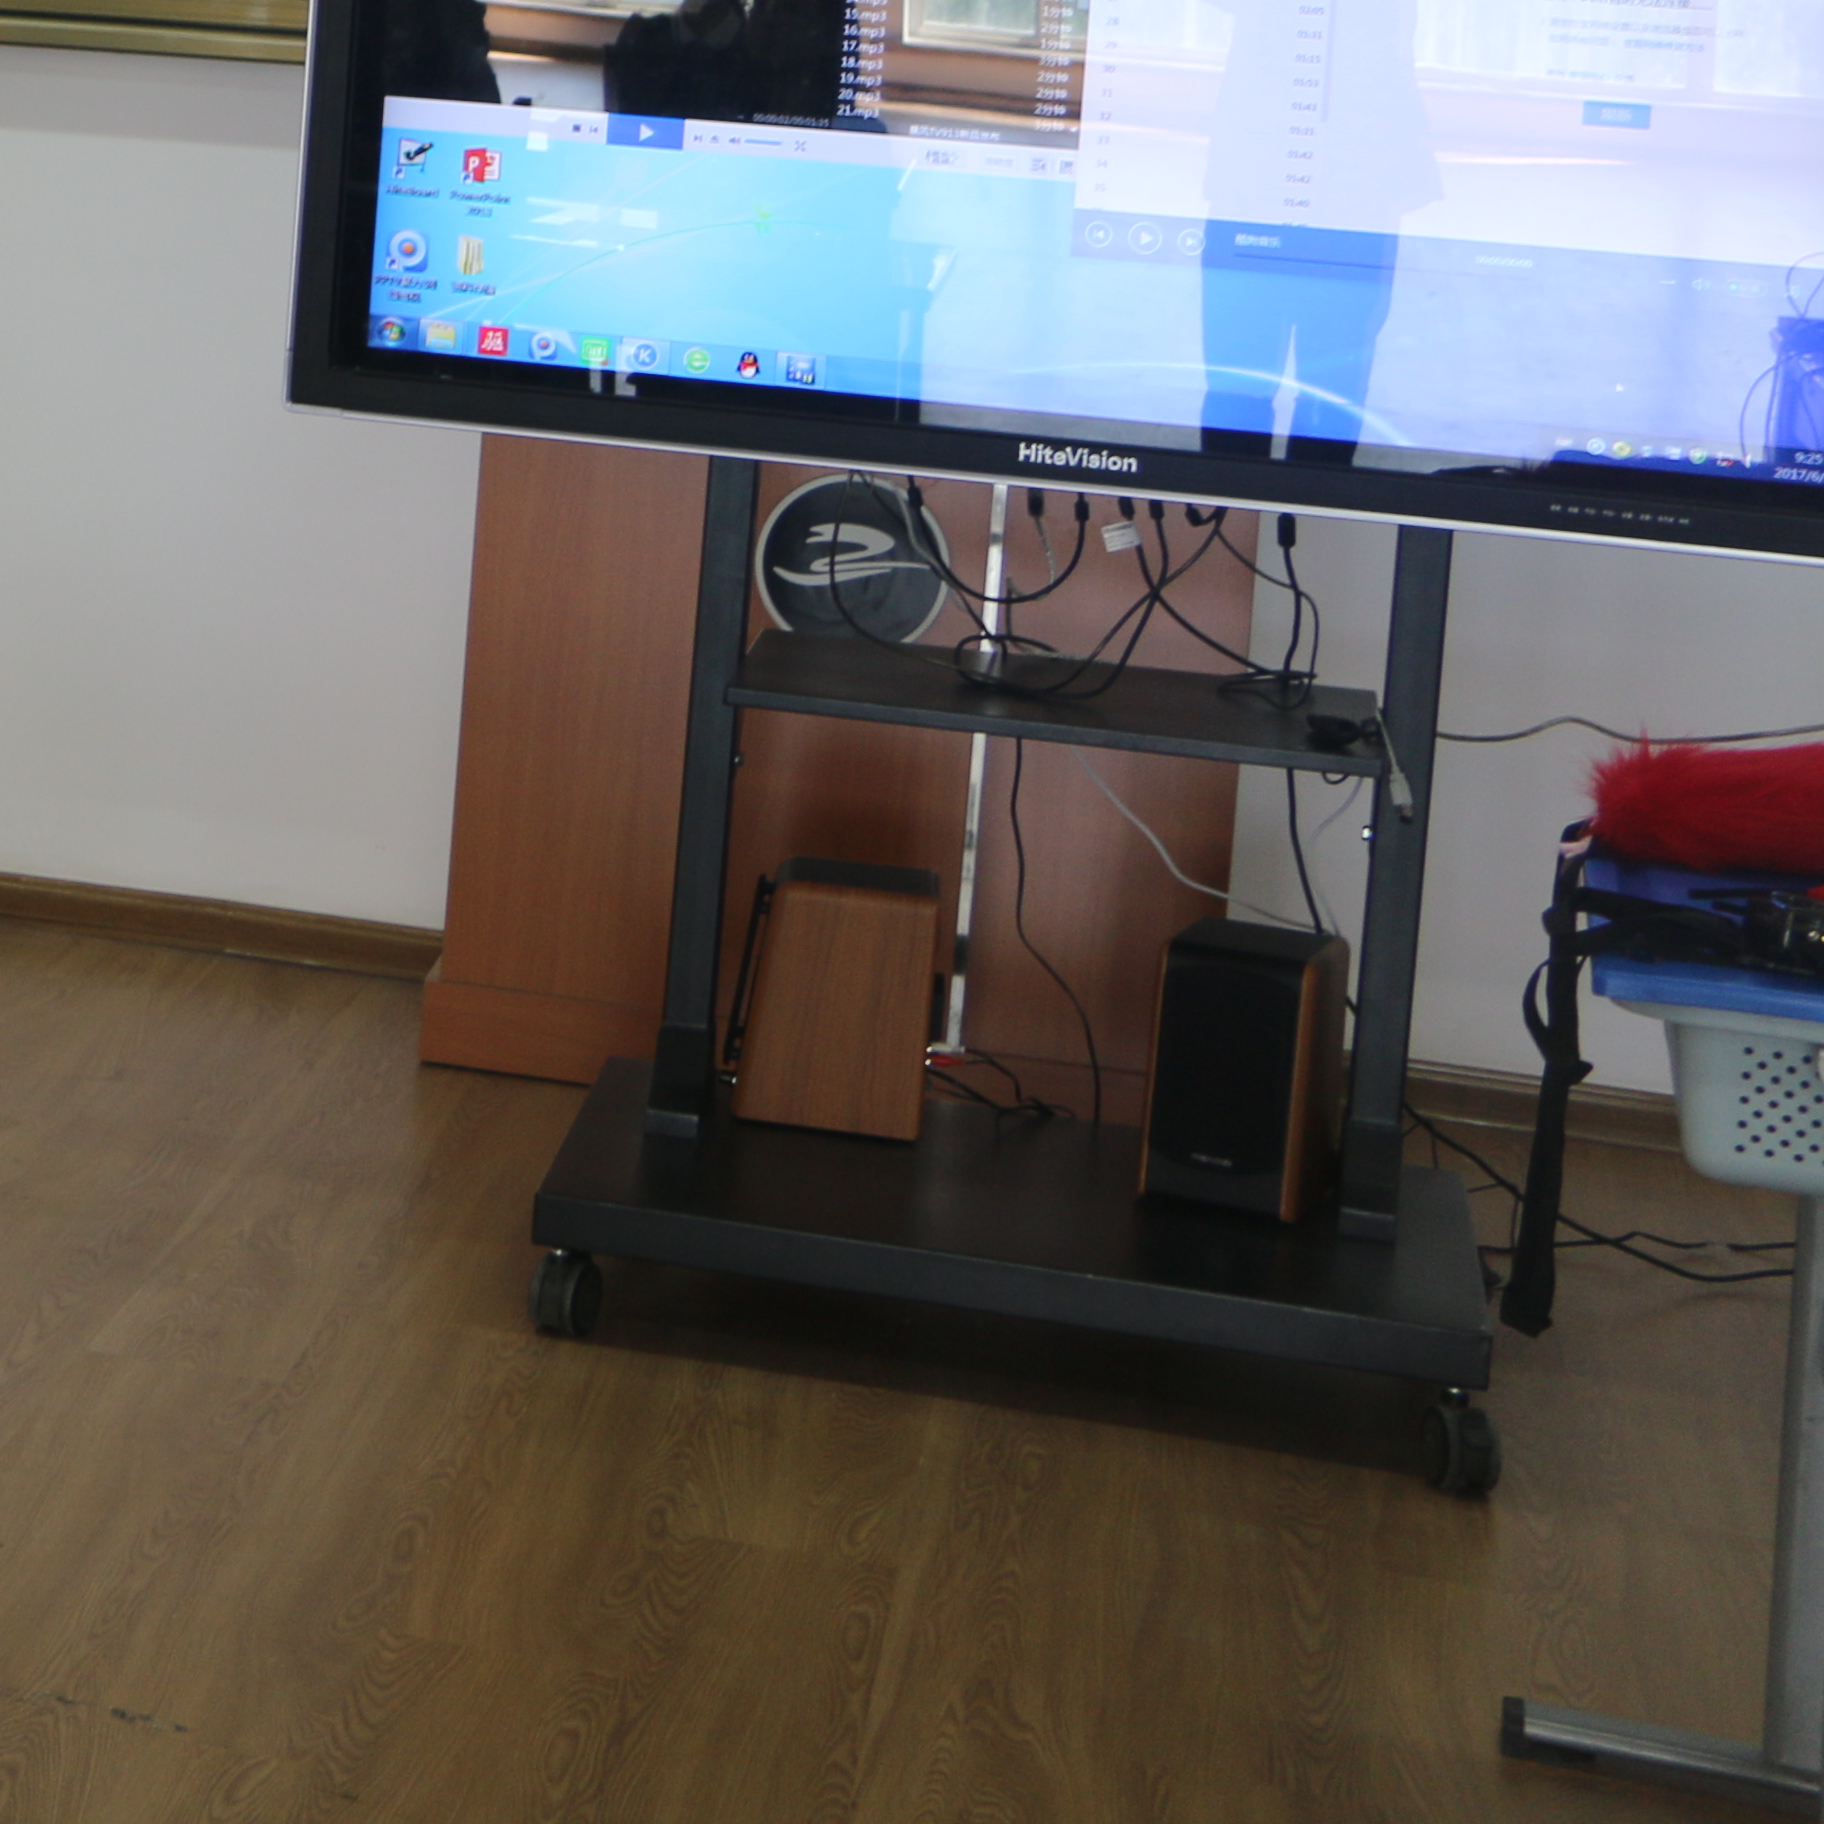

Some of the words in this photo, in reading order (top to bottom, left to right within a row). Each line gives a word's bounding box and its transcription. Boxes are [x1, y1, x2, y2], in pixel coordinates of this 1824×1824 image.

[845, 8, 887, 23] 15.mp3
[844, 25, 886, 39] 16.mp3
[842, 41, 885, 55] 17.mp3
[841, 57, 884, 71] 18.mp3
[840, 73, 883, 87] 19.mp3
[838, 89, 881, 104] 20.mp3
[837, 105, 880, 120] 21.mp3
[1017, 440, 1139, 473] HiteVision
[1795, 451, 1823, 465] 9:25
